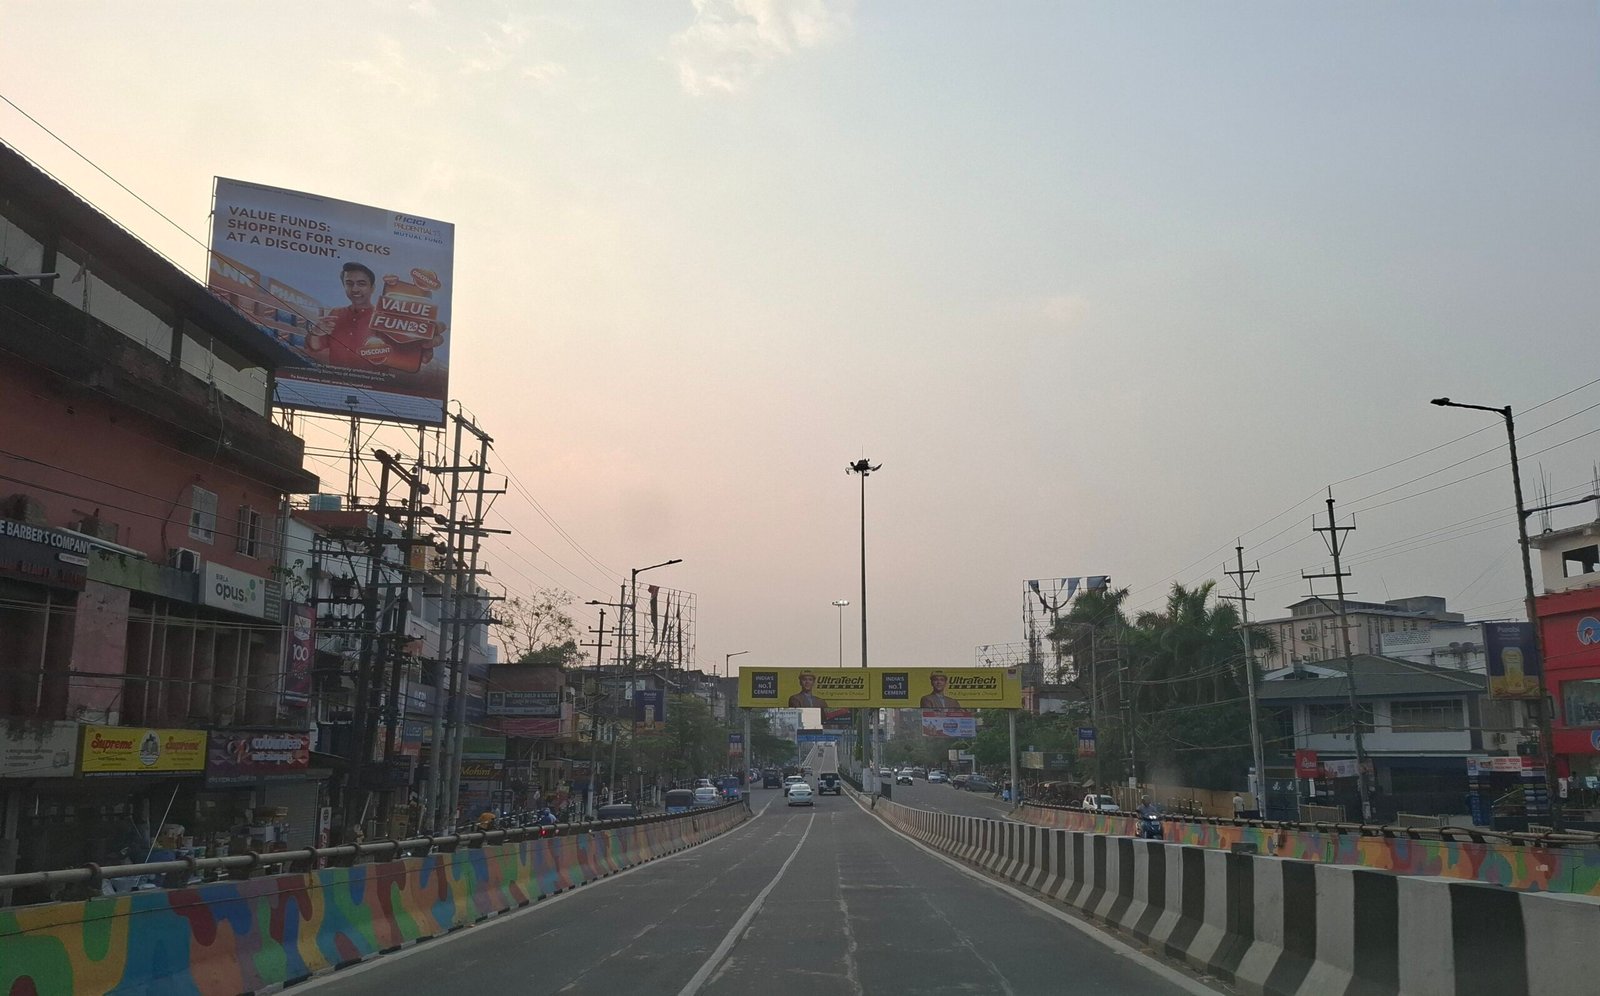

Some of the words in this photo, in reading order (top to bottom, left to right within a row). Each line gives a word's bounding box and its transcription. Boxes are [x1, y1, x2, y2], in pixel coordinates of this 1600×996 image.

[229, 206, 276, 222] VALUE
[281, 215, 330, 232] FUNDS:
[403, 217, 426, 226] ICICI
[226, 232, 246, 243] AT
[250, 236, 260, 245] A
[265, 237, 340, 259] DISCOUNT.
[228, 219, 301, 239] SHOPPING
[306, 232, 333, 245] FOR
[338, 238, 391, 255] STOCKS
[394, 231, 422, 240] MUTUAL
[425, 237, 443, 245] FUND
[412, 270, 439, 287] DISCOUNT
[382, 298, 432, 316] VALUE
[374, 316, 428, 334] FUNDS
[361, 347, 390, 357] DISCOUNT
[6, 521, 50, 544] BARBER'S
[50, 533, 91, 554] COMPANY
[215, 573, 228, 582] BIRLA
[293, 643, 308, 661] 100
[817, 675, 864, 684] UltraTech
[888, 682, 902, 690] NO.1
[948, 675, 996, 684] UltraTech
[91, 733, 134, 752] Supreme
[165, 736, 199, 752] Supreme
